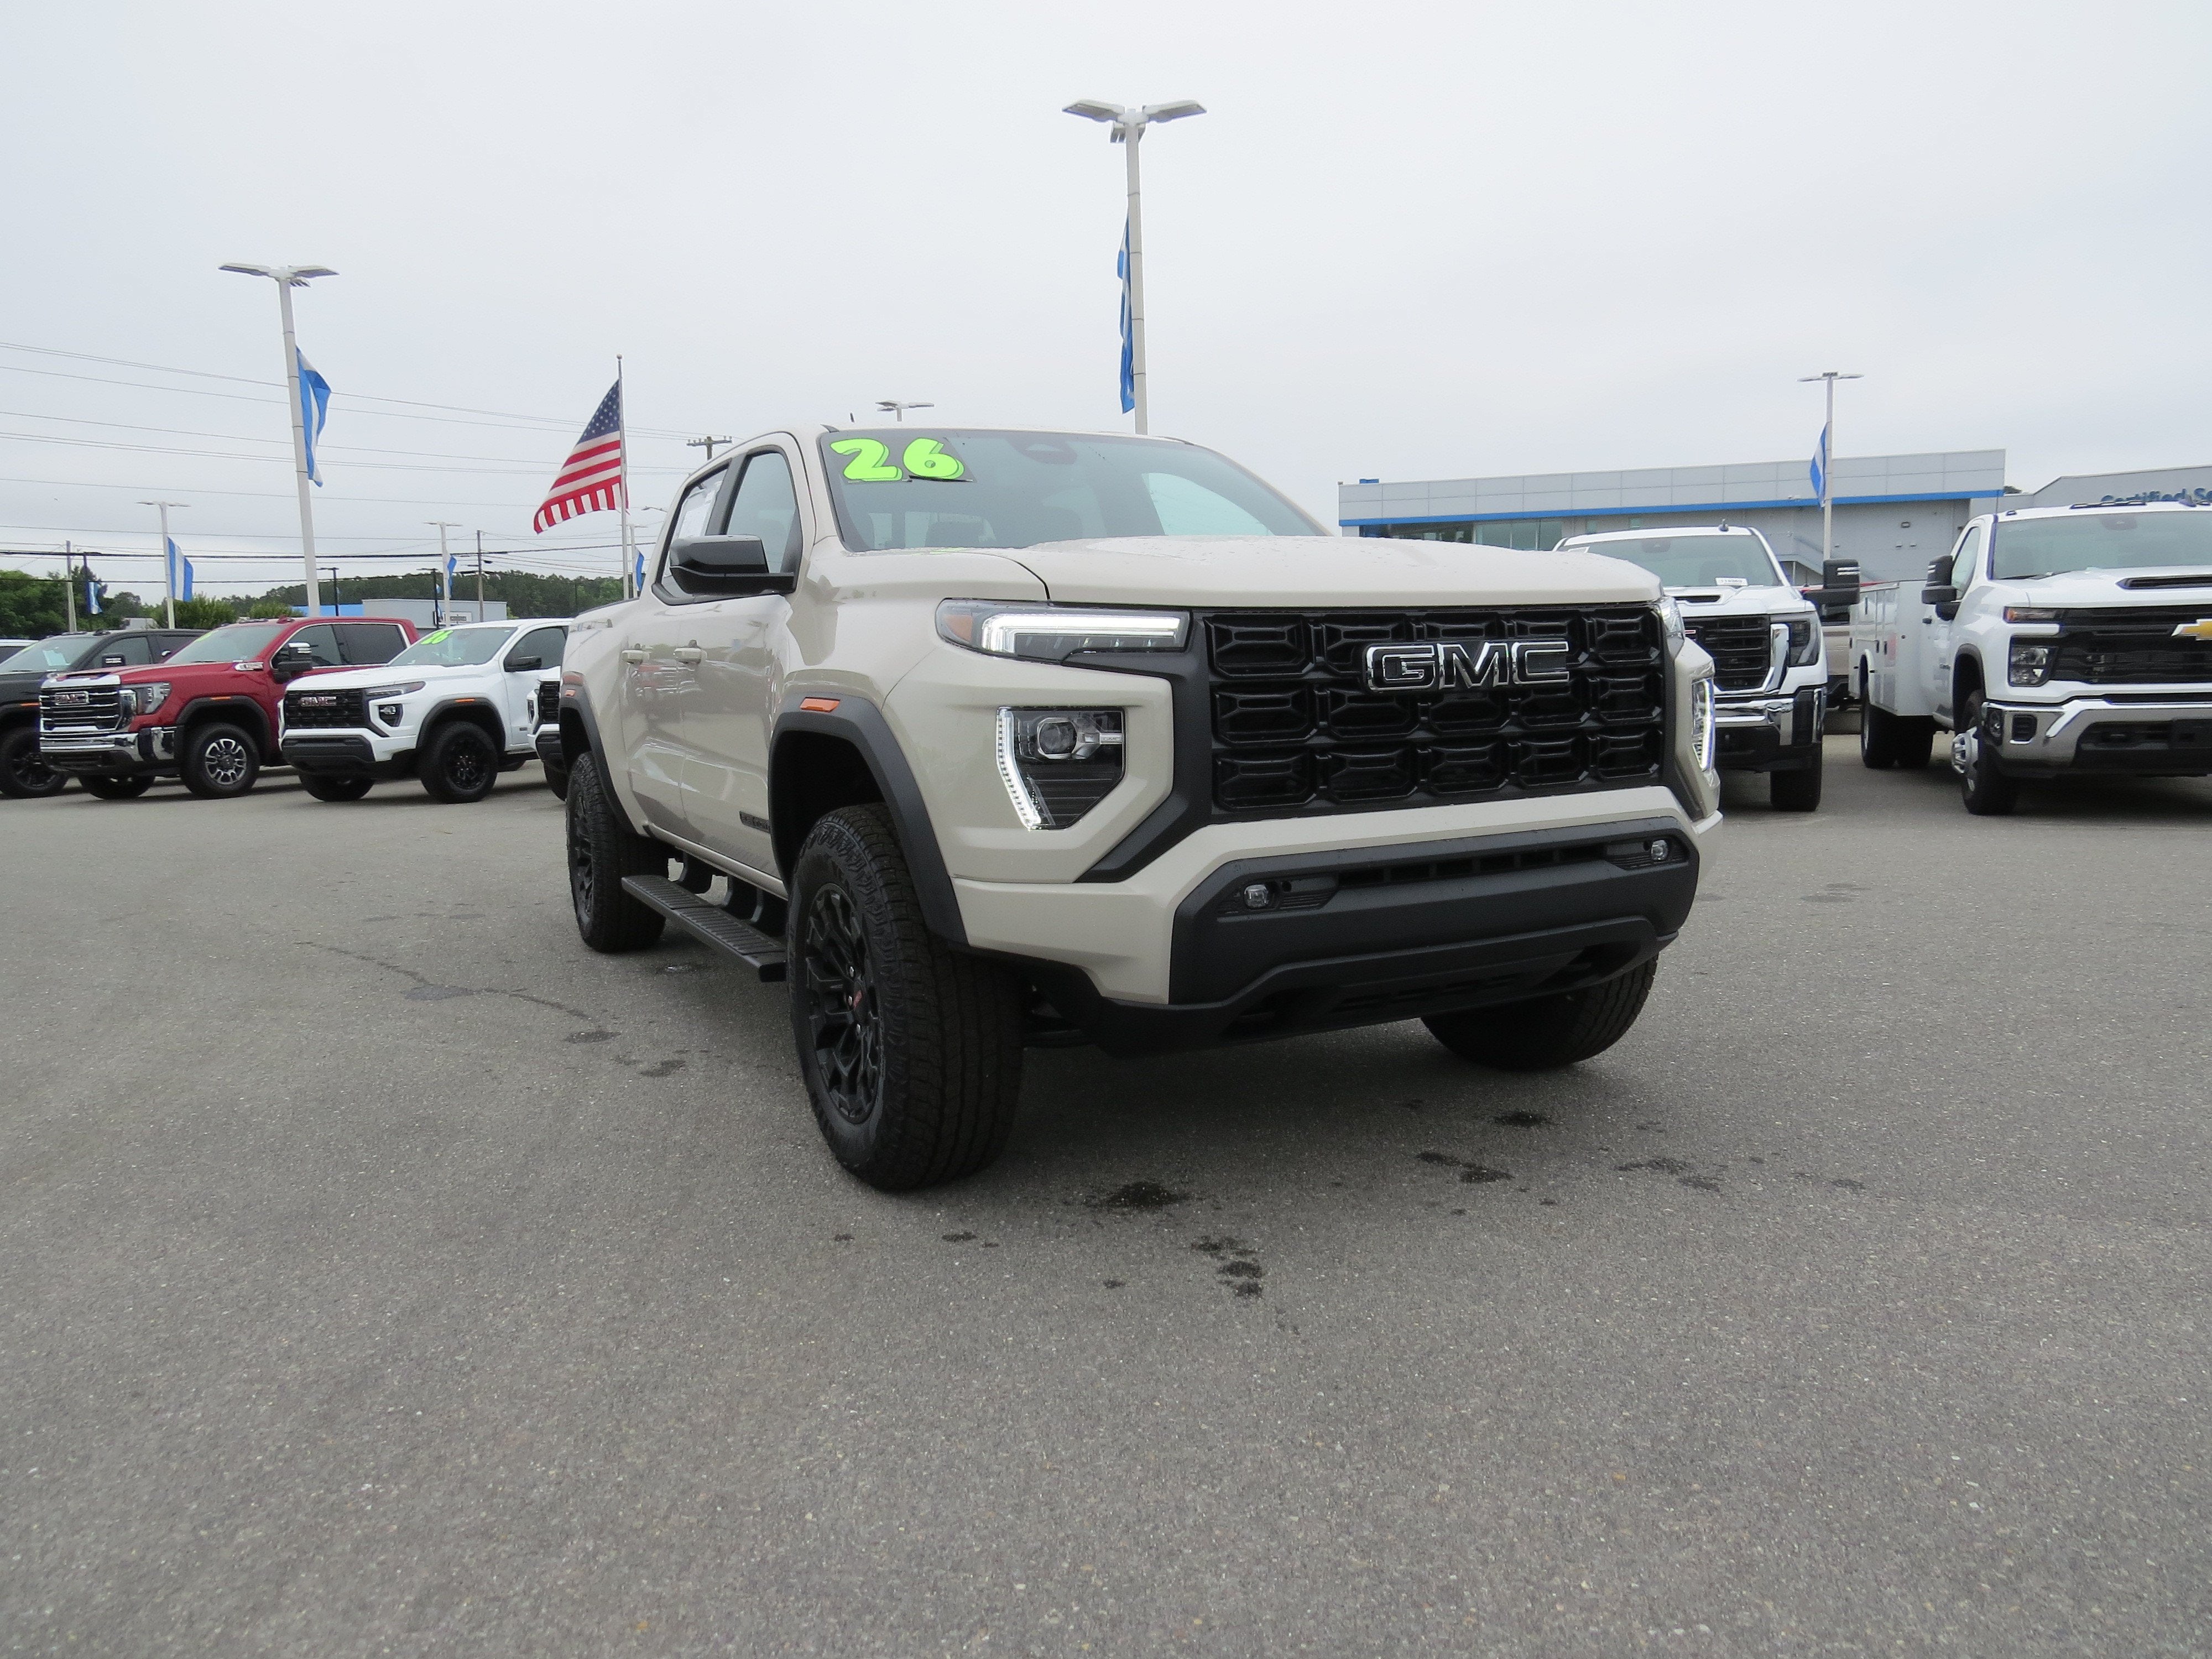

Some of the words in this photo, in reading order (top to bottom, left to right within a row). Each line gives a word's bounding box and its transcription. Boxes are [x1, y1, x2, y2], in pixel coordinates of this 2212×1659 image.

[830, 437, 964, 481] 26
[1366, 640, 1569, 691] GMC
[300, 697, 337, 707] GMC
